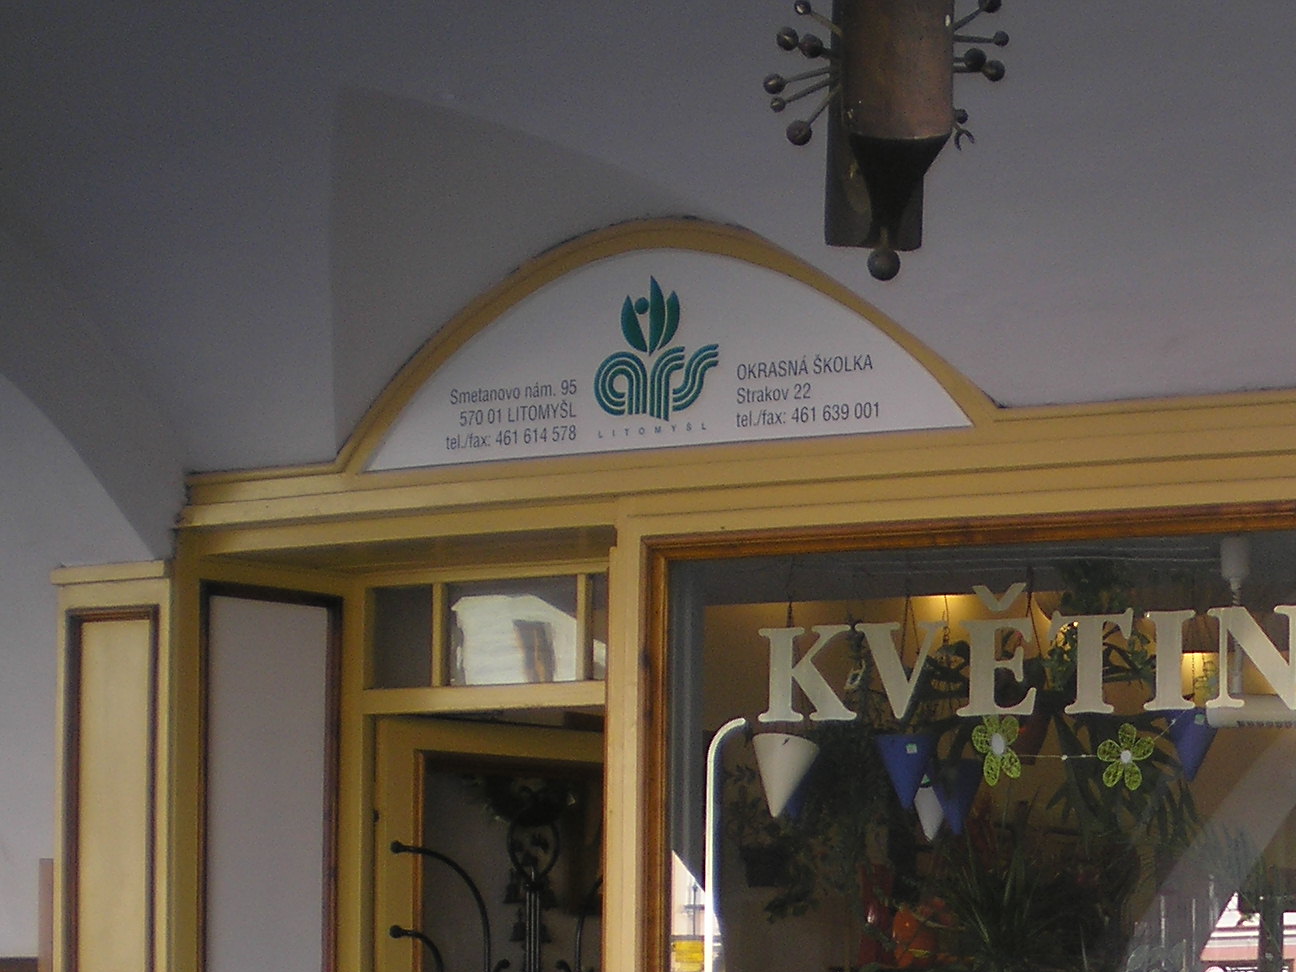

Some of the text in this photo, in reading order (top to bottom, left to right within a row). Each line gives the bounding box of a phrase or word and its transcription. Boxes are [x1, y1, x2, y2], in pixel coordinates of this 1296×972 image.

[736, 353, 873, 381] OKRASNÁ ŠKOLKA
[450, 379, 577, 406] Smetanovo nám. 95
[736, 383, 811, 404] Strakov 22
[459, 400, 576, 427] 570 01 LITOMYŠL
[736, 401, 880, 429] tel./fax: 461 639 001
[446, 425, 577, 451] tel./fax: 461 614 578
[598, 421, 707, 439] LITOMYŠL
